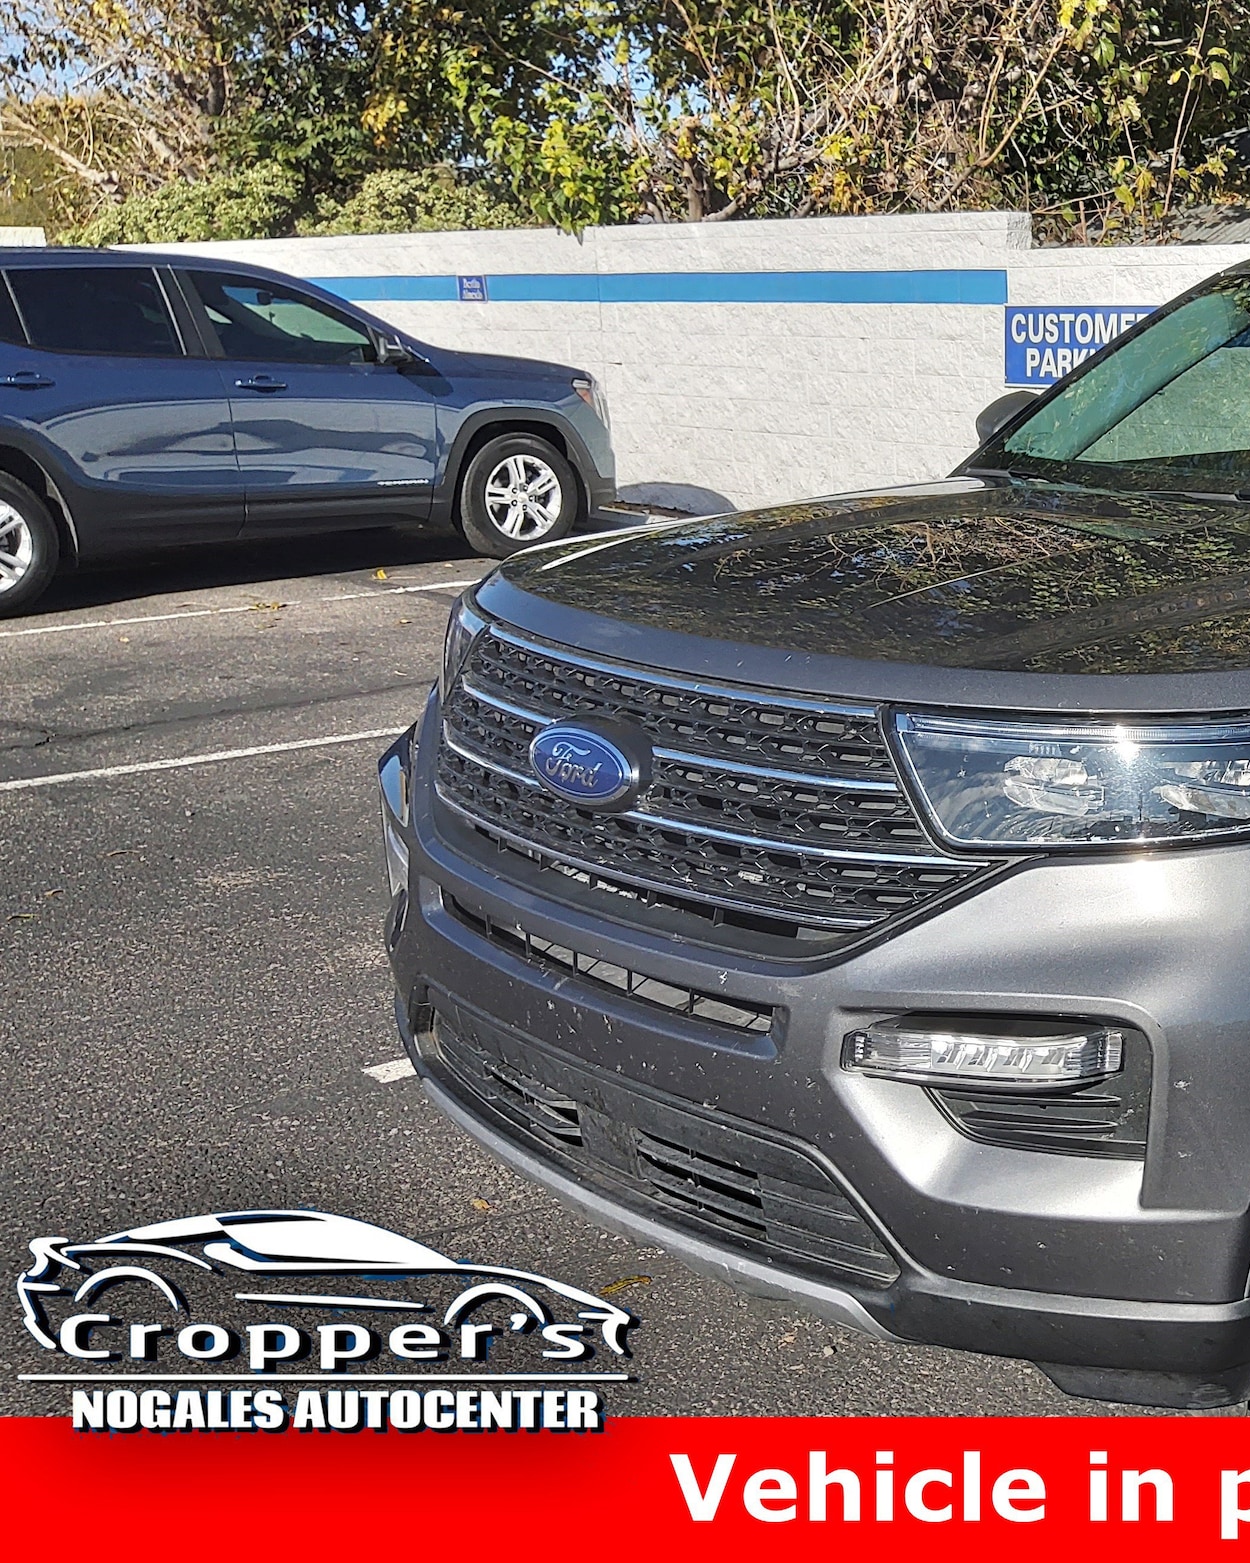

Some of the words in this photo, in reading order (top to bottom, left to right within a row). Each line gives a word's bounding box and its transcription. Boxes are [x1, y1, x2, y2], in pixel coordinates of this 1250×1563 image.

[1011, 313, 1149, 344] CUSTOME
[1026, 347, 1100, 378] PARK
[545, 741, 603, 788] Ford
